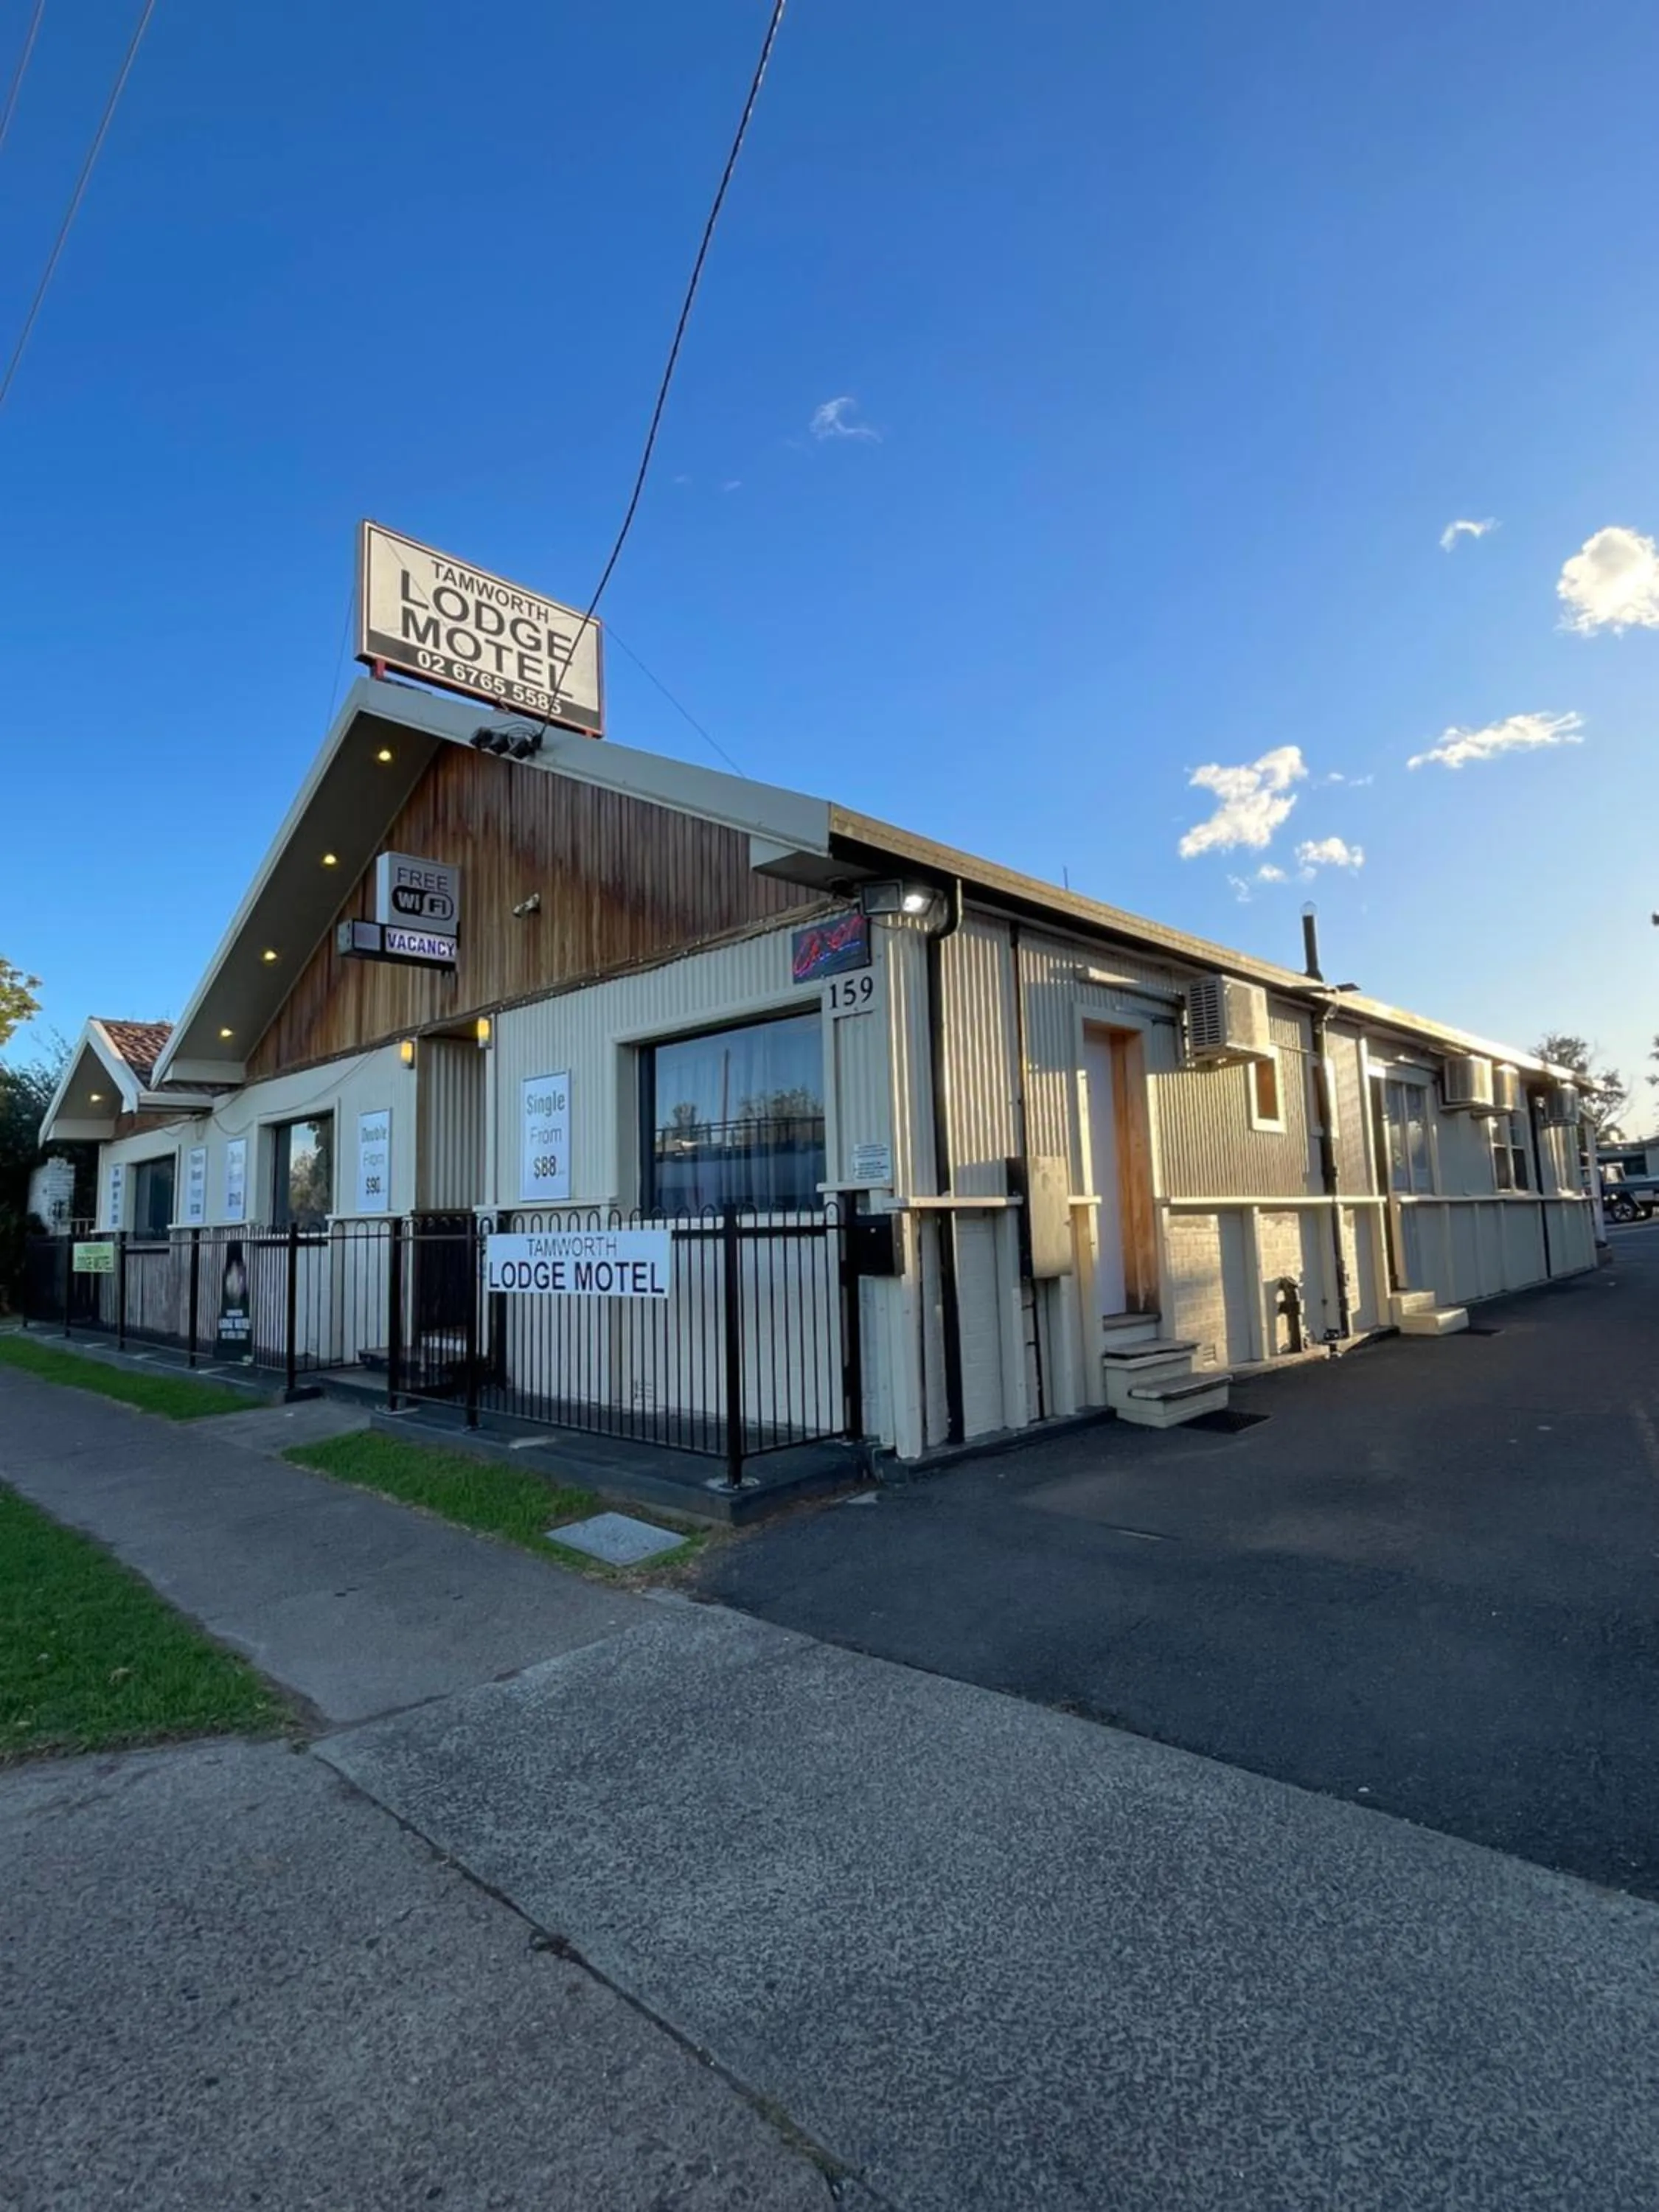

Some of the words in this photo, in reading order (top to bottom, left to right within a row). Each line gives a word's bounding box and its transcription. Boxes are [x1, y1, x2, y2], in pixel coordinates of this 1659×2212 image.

[431, 560, 549, 624] TAMWORTH
[401, 569, 572, 665] LODGE
[402, 605, 573, 699] MOTEL
[417, 650, 445, 674] 02
[452, 663, 506, 695] 6765
[397, 866, 448, 892] FREE
[387, 931, 455, 957] VACANCY
[830, 975, 874, 1009] 159
[526, 1090, 565, 1118] Single
[530, 1126, 562, 1144] From
[527, 1237, 616, 1256] TAMWORTH
[490, 1262, 566, 1290] LODGE
[574, 1262, 665, 1293] MOTEL
